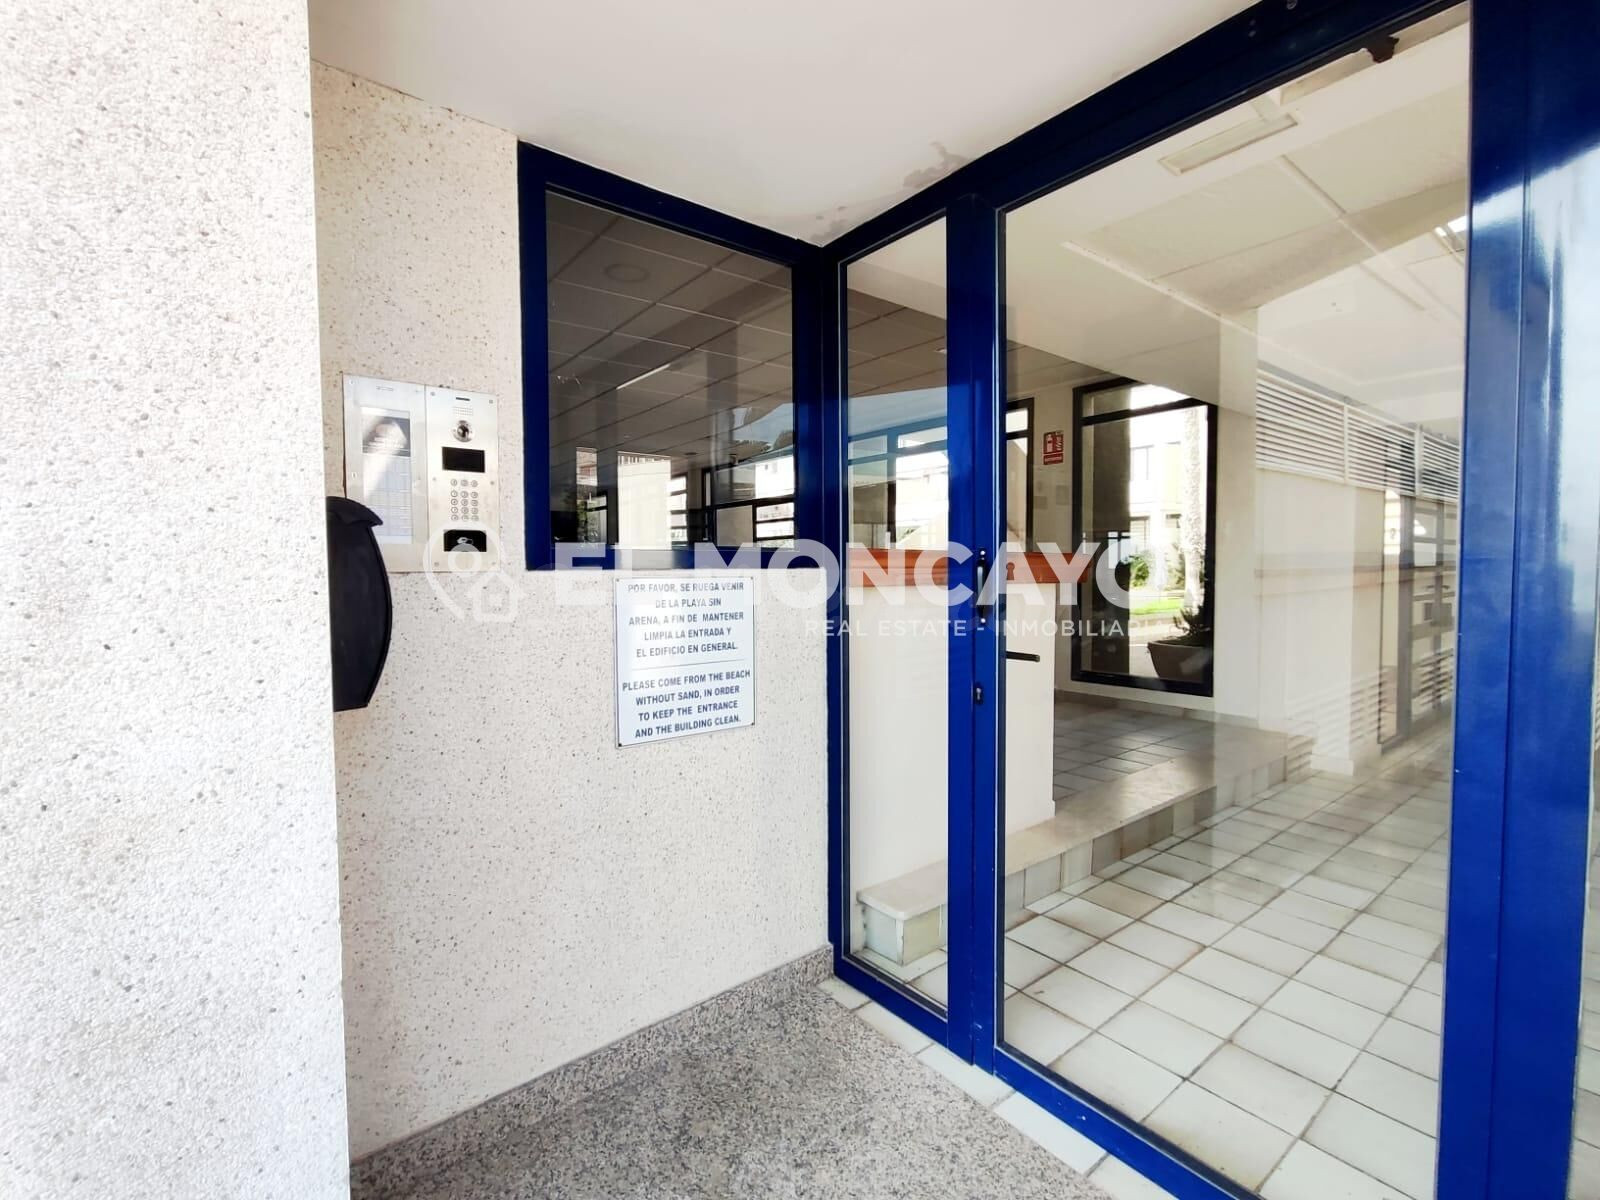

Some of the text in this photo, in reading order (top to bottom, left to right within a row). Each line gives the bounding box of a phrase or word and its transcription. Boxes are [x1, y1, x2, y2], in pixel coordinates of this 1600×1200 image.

[628, 582, 744, 594] POR FAVOR, SE RUEGA VENIR
[655, 598, 721, 609] DE LA PLAYA SIN
[628, 612, 744, 626] ARENA, A FIN DE MANTENER
[644, 627, 731, 641] LIMPIA LA ENTRADA Y
[636, 642, 738, 658] EL EDIFICIO EN GENERAL.
[622, 670, 750, 691] PLEASE COME FROM THE BEACH
[636, 685, 740, 706] WITHOUT SAND, IN ORDER
[638, 700, 738, 722] TO KEEP THE ENTRANCE
[635, 715, 741, 738] AND THE BUILDING CLEAN.
